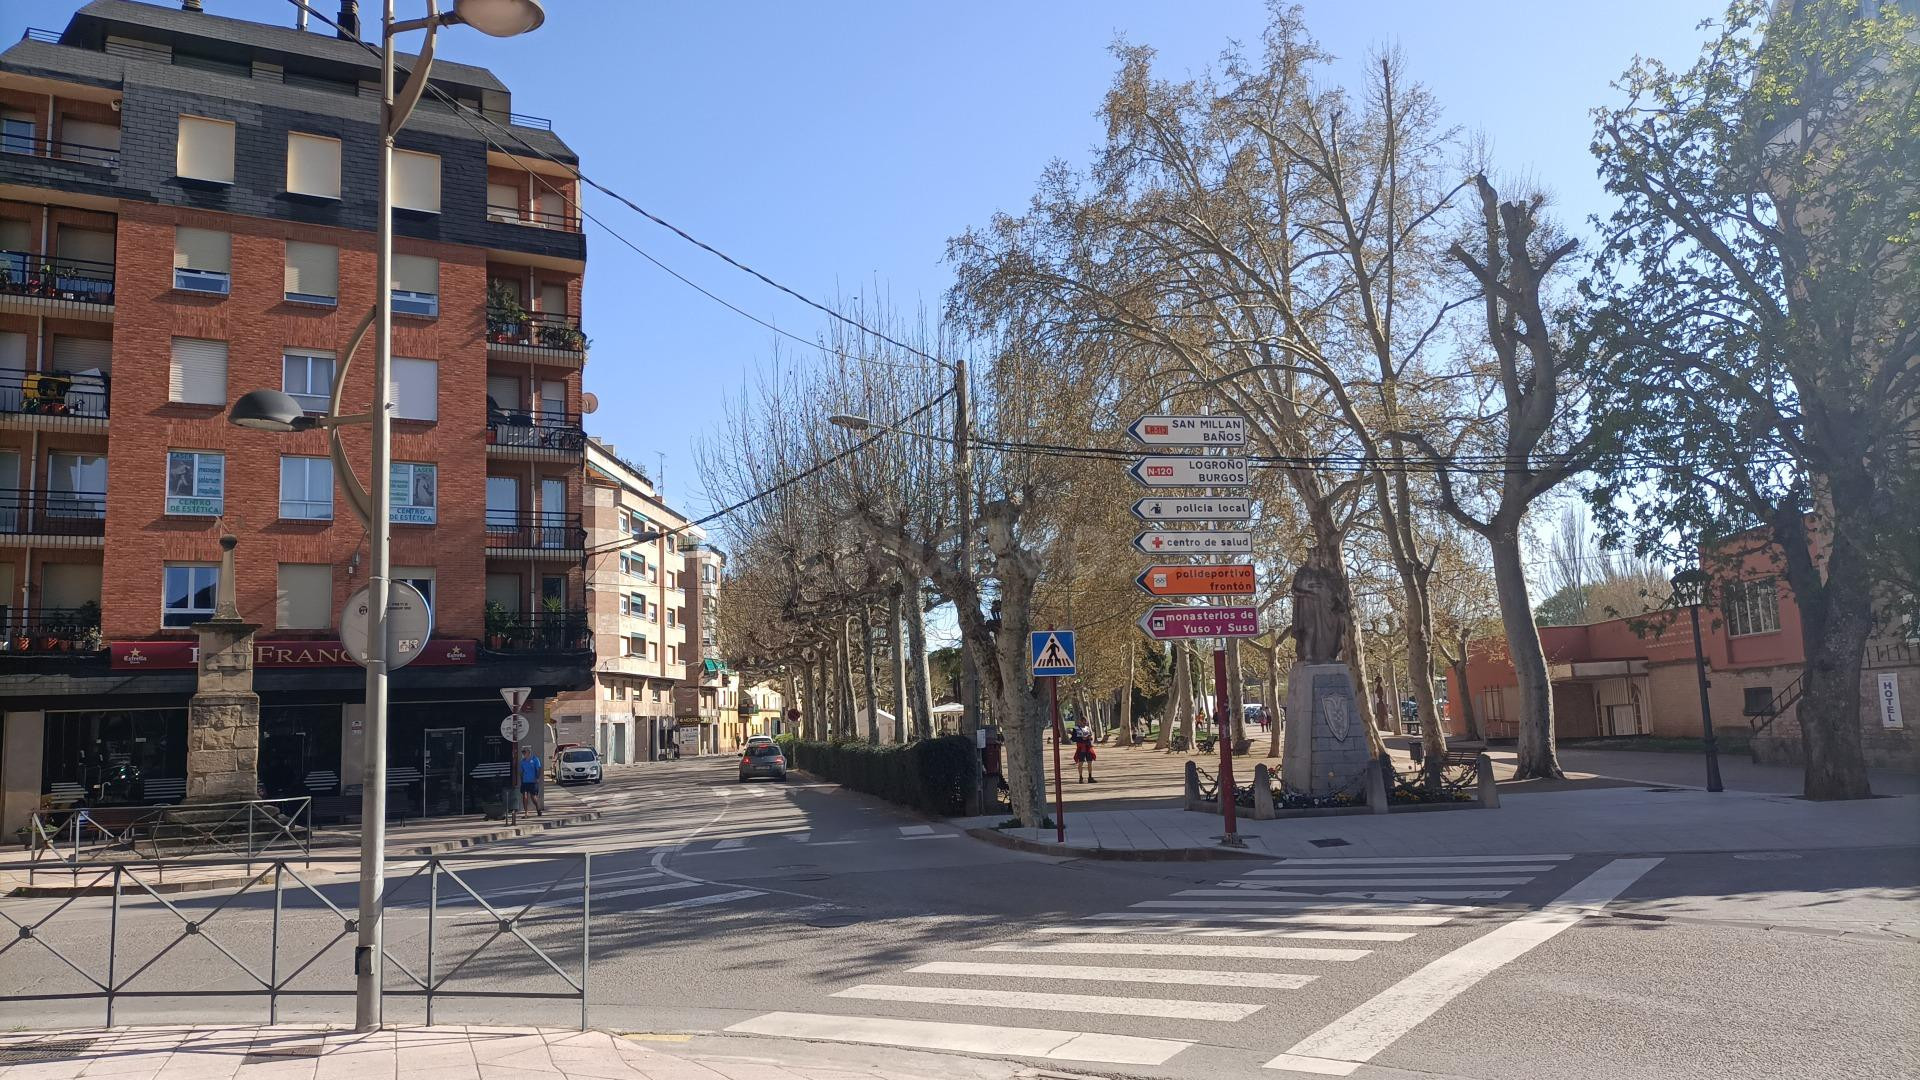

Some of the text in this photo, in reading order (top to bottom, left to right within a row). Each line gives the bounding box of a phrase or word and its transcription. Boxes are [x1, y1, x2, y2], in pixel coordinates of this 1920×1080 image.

[1172, 420, 1241, 428] SAN MILLAN
[1203, 430, 1241, 441] BAÑOS
[1189, 459, 1243, 469] LOGROÑO
[1148, 467, 1172, 475] N-120
[1199, 473, 1244, 482] BURGOS
[1219, 504, 1246, 512] local
[1167, 538, 1249, 547] centro de salud
[1176, 570, 1251, 580] polideportivo
[1210, 582, 1252, 591] frontón
[1166, 611, 1254, 622] monasterios de
[1183, 623, 1255, 634] Yuso y Suso
[255, 646, 352, 663] FRANC
[1884, 682, 1895, 722] HOTEL
